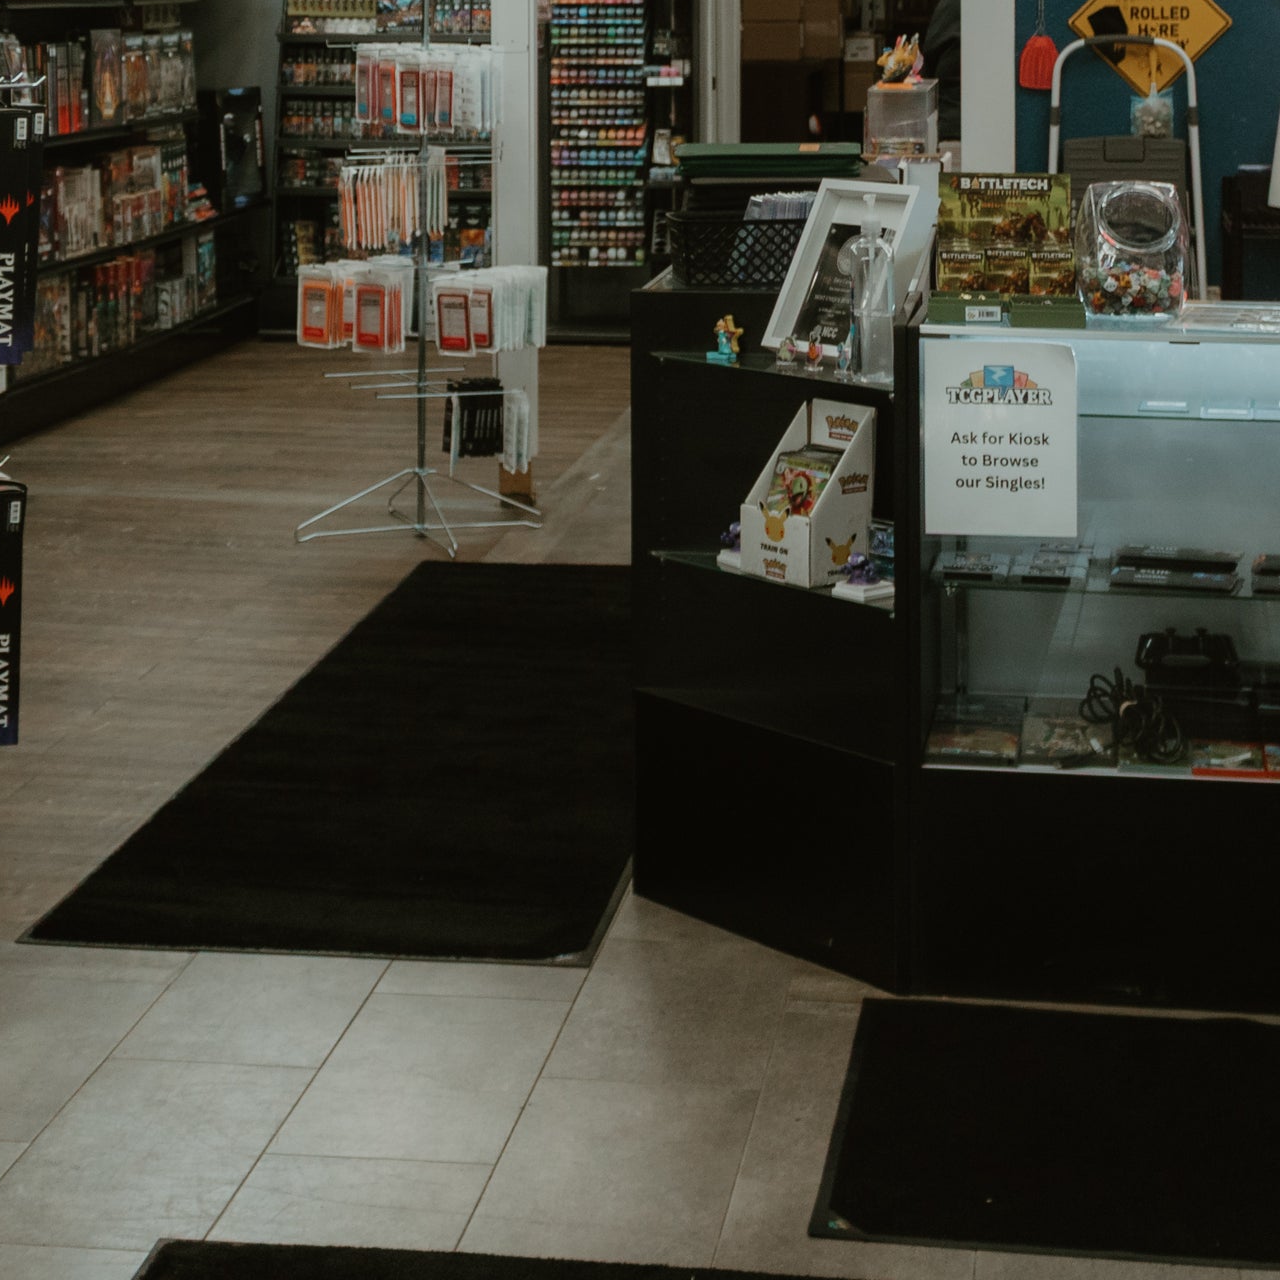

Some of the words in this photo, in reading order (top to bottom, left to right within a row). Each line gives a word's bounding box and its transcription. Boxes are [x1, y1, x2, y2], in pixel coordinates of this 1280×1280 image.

[1130, 6, 1190, 21] ROLLED
[960, 177, 1049, 191] BATTLETECH
[946, 387, 1053, 406] TCGPLAYER
[951, 432, 978, 445] Ask
[982, 431, 1004, 445] for
[1008, 432, 1050, 445] Kiosk
[961, 455, 977, 467] to
[982, 453, 1039, 467] Browse
[955, 477, 981, 489] our
[985, 475, 1046, 492] Singles!
